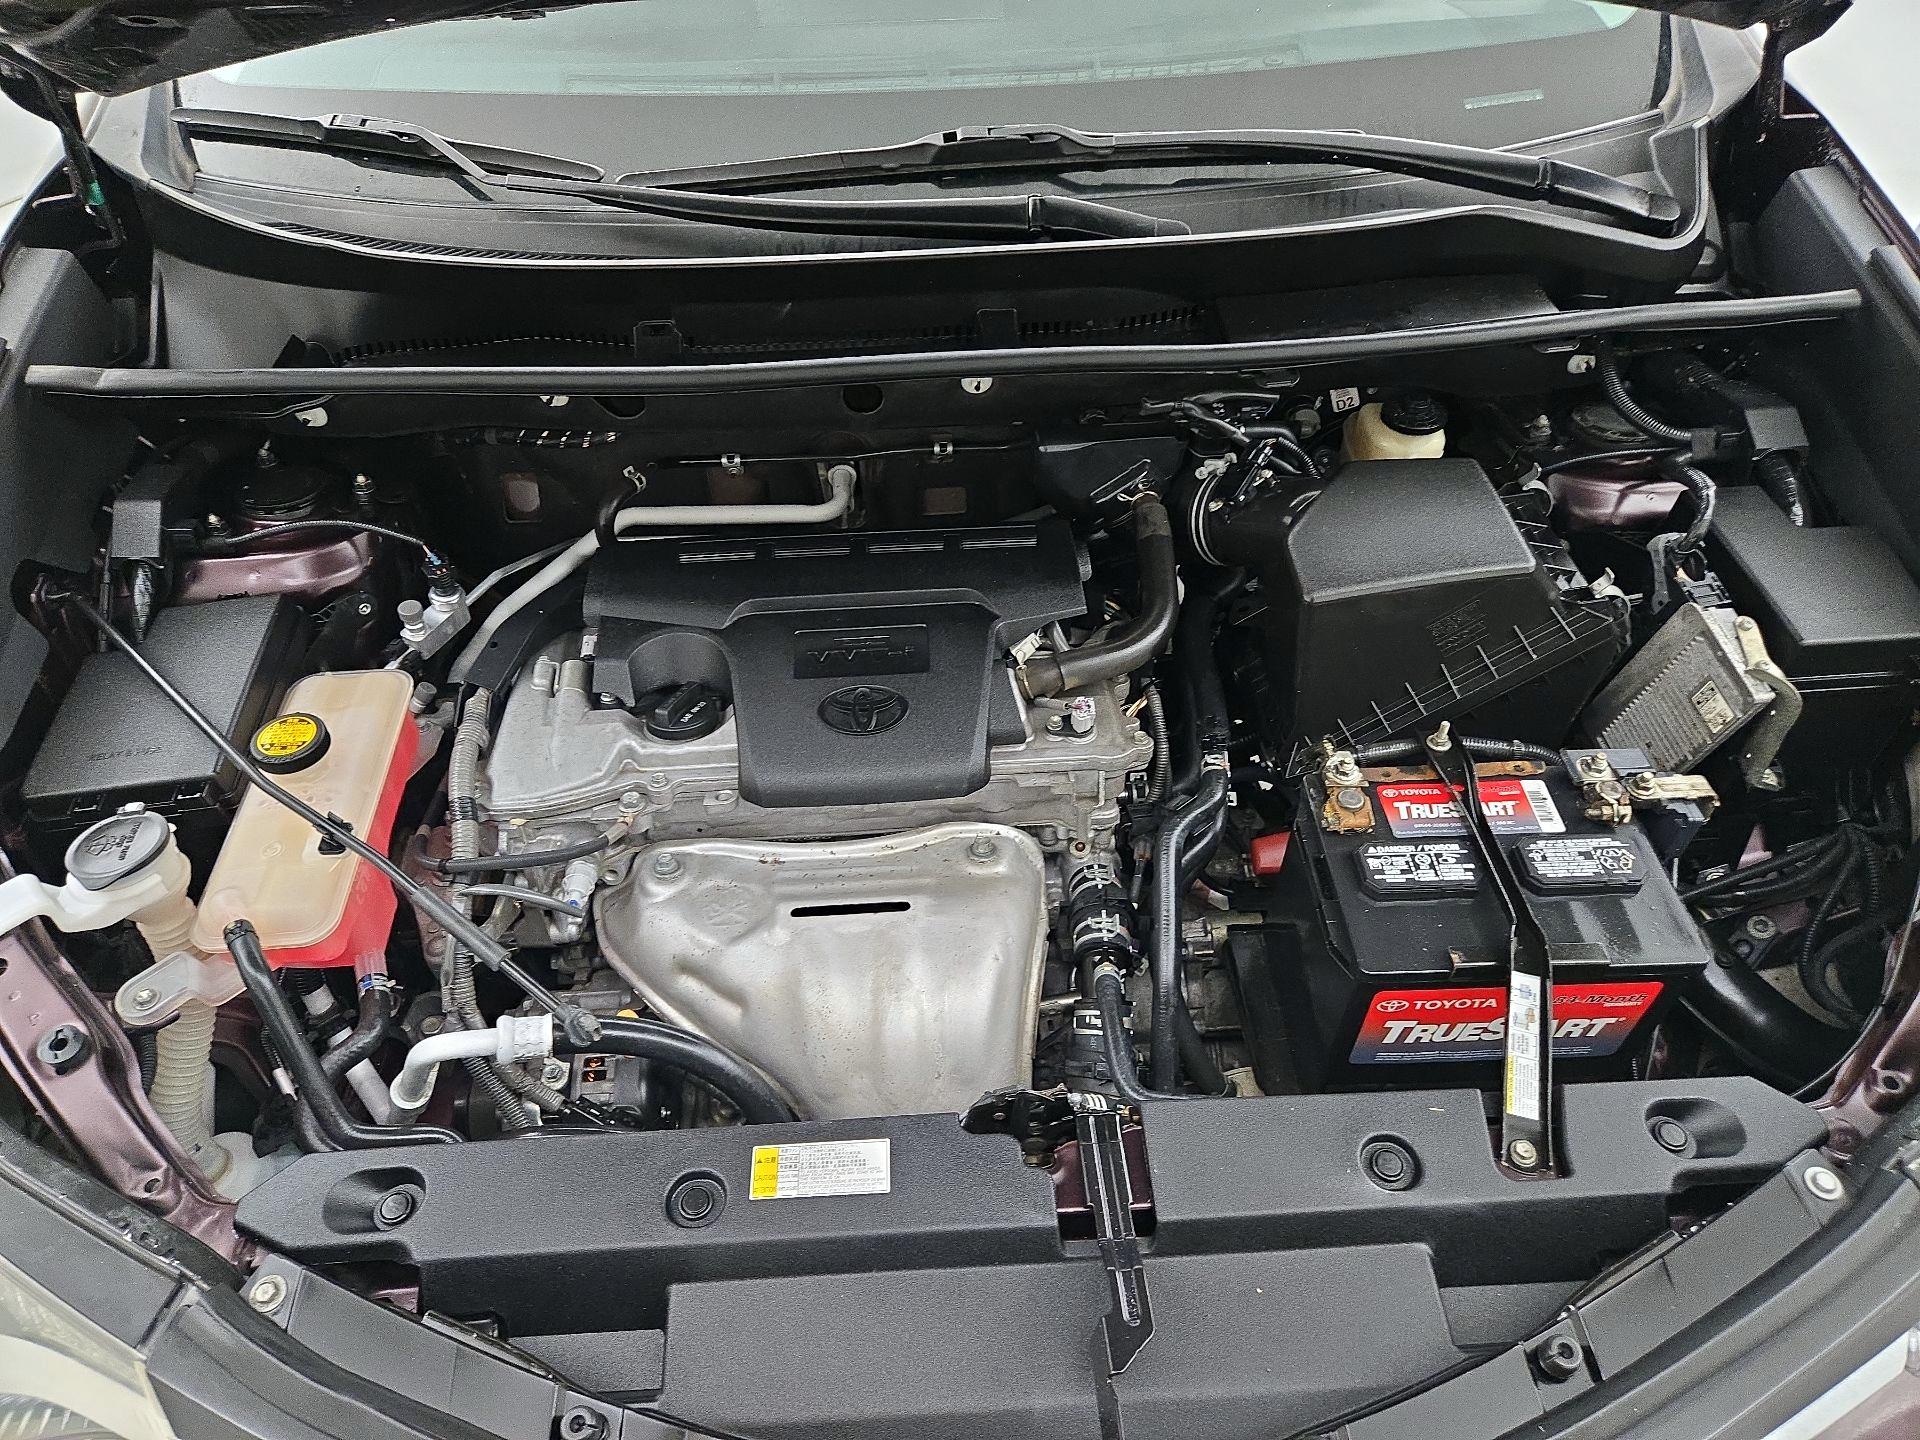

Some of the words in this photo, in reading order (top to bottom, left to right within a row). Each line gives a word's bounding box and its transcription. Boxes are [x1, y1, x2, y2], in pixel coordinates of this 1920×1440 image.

[1336, 397, 1355, 410] D2
[1398, 788, 1442, 796] TOYOTA
[1393, 800, 1516, 820] TRUESRT
[1413, 998, 1498, 1010] TOYOTA
[1381, 1016, 1619, 1044] TRUESRT
